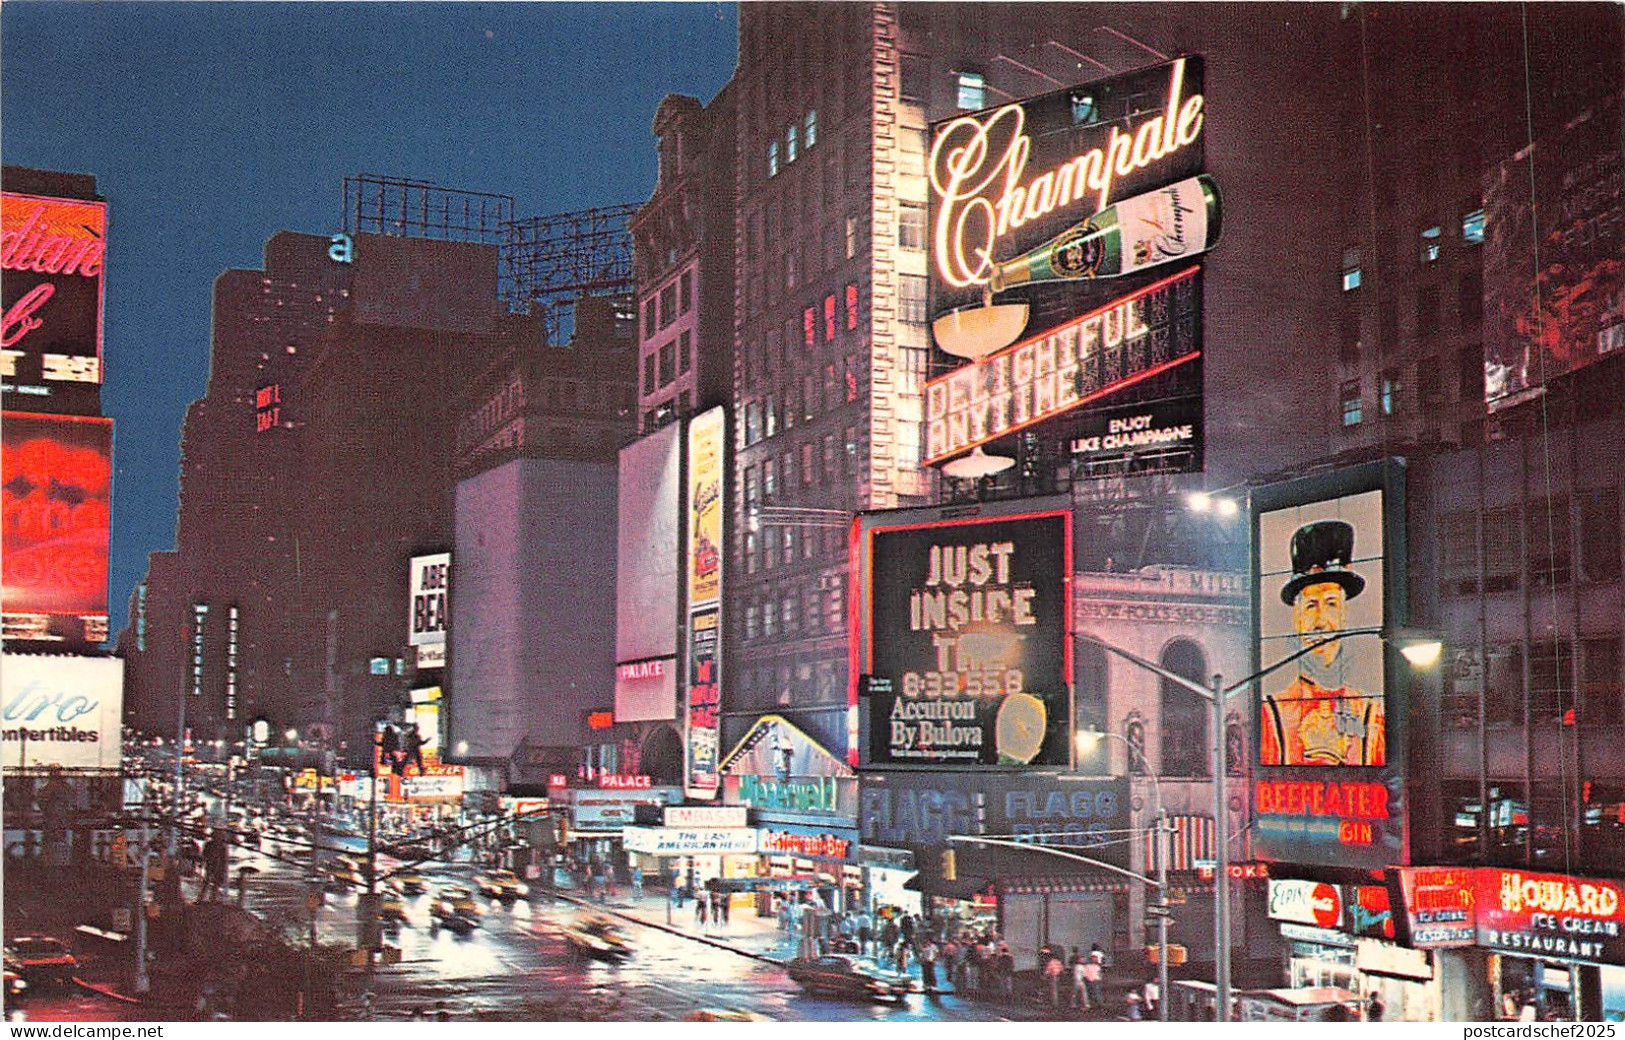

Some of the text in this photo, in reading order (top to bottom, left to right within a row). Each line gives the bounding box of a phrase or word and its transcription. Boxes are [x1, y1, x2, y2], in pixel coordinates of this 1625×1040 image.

[928, 56, 1204, 288] Champale
[329, 233, 353, 264] a
[927, 300, 1150, 420] DELIGHTFUL
[1109, 415, 1153, 434] ENJOY
[1070, 425, 1194, 454] LIKE CHAMPAGNE
[926, 541, 1015, 588] JUST
[911, 584, 1036, 632] INSIDE
[622, 662, 664, 680] PALACE
[889, 696, 976, 720] Accutron
[890, 720, 983, 749] By Bulova
[600, 775, 651, 788] PALACE
[1256, 780, 1390, 820] BEEFEATER
[669, 809, 745, 823] EMBASSY
[657, 841, 717, 849] AMERICAN
[678, 832, 698, 840] THE
[1338, 821, 1373, 846] GIN
[1202, 864, 1269, 878] BOKS
[1500, 872, 1619, 916] HOWARD
[1530, 912, 1558, 930] ICE
[1488, 929, 1604, 957] RESTAURANT
